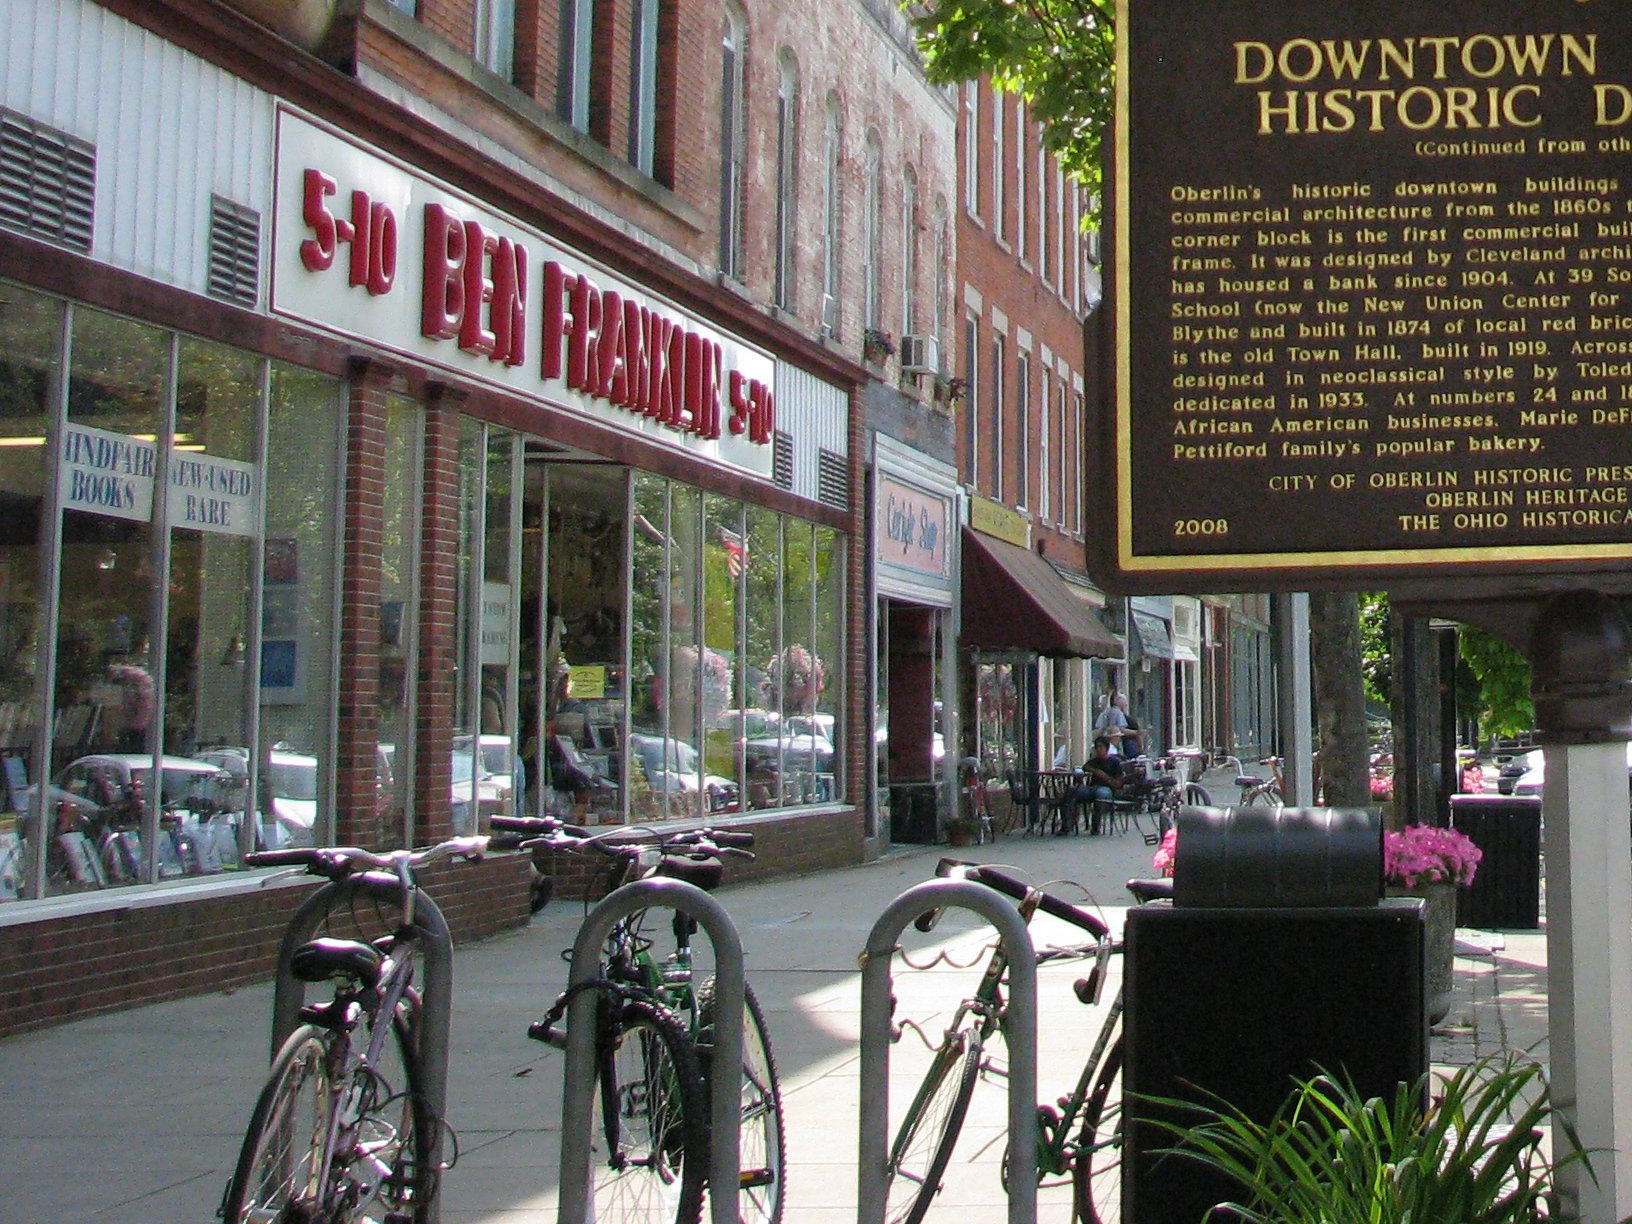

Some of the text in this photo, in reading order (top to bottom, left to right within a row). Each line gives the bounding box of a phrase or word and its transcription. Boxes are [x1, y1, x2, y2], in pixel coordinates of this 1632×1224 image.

[1232, 33, 1598, 86] DOWNTOWN
[1257, 84, 1543, 136] HISTORIC
[1538, 137, 1587, 154] from
[1170, 184, 1261, 202] Oberlin's
[1291, 181, 1372, 200] historic
[1394, 180, 1498, 197] downtown
[1525, 176, 1619, 196] buildings
[1171, 207, 1290, 225] commercial
[1302, 204, 1432, 222] architecture
[1445, 201, 1495, 218] from
[1507, 200, 1540, 217] the
[1553, 197, 1612, 216] 1860s
[1171, 234, 1241, 248] corner
[1257, 229, 1312, 247] block
[1355, 227, 1388, 244] the
[1402, 226, 1447, 243] first
[1462, 222, 1579, 241] commercial
[1274, 255, 1312, 269] was
[1322, 250, 1413, 271] designed
[1427, 248, 1452, 268] by
[1465, 245, 1566, 263] Cleveland
[1171, 279, 1205, 294] has
[1218, 276, 1290, 294] housed
[1328, 273, 1378, 291] bank
[1394, 272, 1448, 289] since
[1533, 269, 1555, 285] At
[1568, 267, 1594, 284] 39
[301, 169, 773, 446] 5-10 BEN FRANKLIN 5-10
[1171, 301, 1240, 318] School
[1254, 299, 1303, 316] (now
[1316, 299, 1349, 315] the
[1363, 296, 1406, 313] New
[1425, 295, 1484, 311] Union
[1501, 293, 1571, 309] Center
[1589, 291, 1620, 308] for
[1172, 325, 1239, 344] Blythe
[1249, 323, 1286, 340] and
[1298, 321, 1346, 339] built
[1357, 320, 1376, 337] in
[1387, 319, 1431, 336] 1874
[1444, 318, 1465, 335] of
[1475, 317, 1526, 334] local
[1542, 316, 1576, 332] red
[1199, 349, 1232, 365] the
[1243, 347, 1274, 364] old
[1286, 346, 1340, 363] Town
[1422, 342, 1469, 359] built
[1479, 341, 1499, 358] in
[1172, 371, 1265, 391] designed
[1285, 370, 1305, 386] in
[1320, 366, 1445, 385] neoclassical
[1463, 364, 1514, 384] style
[1533, 363, 1559, 382] by
[1173, 394, 1276, 413] dedicated
[1289, 393, 1309, 410] in
[1393, 391, 1415, 407] At
[1430, 389, 1516, 406] numbers
[1533, 386, 1557, 403] 24
[1571, 385, 1607, 402] and
[1173, 418, 1254, 436] African
[1269, 416, 1369, 434] American
[1520, 408, 1578, 426] Marie
[1173, 435, 1546, 460] Pettiford family's popular bakery.
[71, 469, 136, 510] BOOKS
[1268, 474, 1318, 491] CITY
[1329, 473, 1356, 490] OF
[1369, 470, 1458, 489] OBERLIN
[1473, 467, 1573, 486] HISTORIC
[186, 494, 231, 526] RARE
[1425, 490, 1514, 508] OBERLIN
[1526, 486, 1628, 505] HERITAGE
[1173, 517, 1229, 536] 2008
[1398, 514, 1440, 532] THE
[1453, 512, 1509, 530] OHIO
